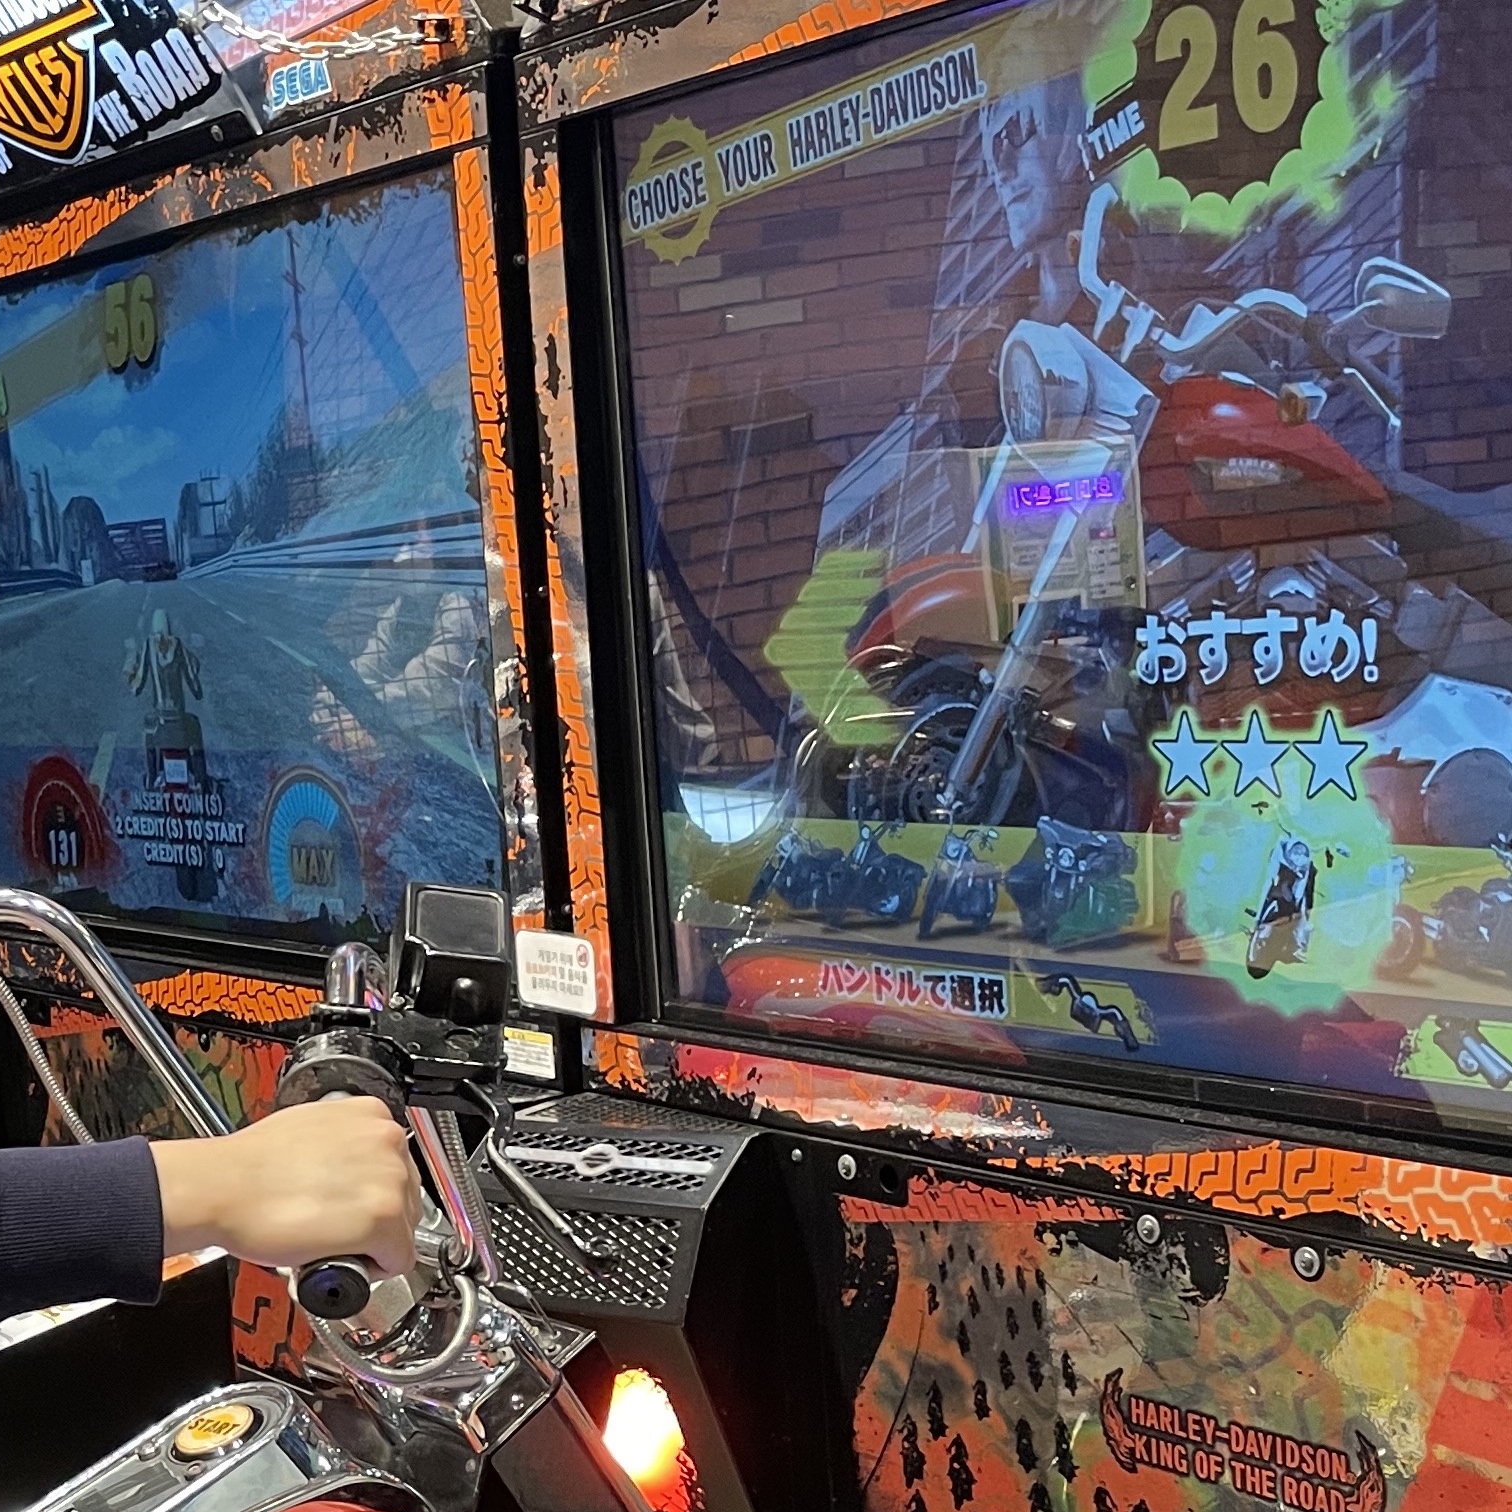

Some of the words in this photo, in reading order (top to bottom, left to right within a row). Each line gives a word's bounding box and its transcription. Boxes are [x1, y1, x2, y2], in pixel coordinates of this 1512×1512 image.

[99, 28, 210, 123] ROAD
[271, 60, 330, 107] SEGA
[1155, 0, 1299, 151] 26
[93, 89, 140, 142] THE
[626, 158, 708, 233] CHOOSE
[716, 130, 778, 195] YOUR
[787, 46, 984, 170] HARLEY-DAVIDSON
[1088, 101, 1146, 160] TIME
[105, 273, 156, 368] 56
[1135, 608, 1379, 685] おすすめ!
[115, 816, 124, 834] 2
[187, 820, 203, 840] TO
[205, 820, 245, 844] START
[132, 792, 171, 813] INSERT
[49, 828, 78, 867] 131
[187, 1417, 240, 1436] START
[1130, 1396, 1350, 1484] HARLEY-DAVIDSON
[1134, 1433, 1188, 1474] KING
[1194, 1450, 1224, 1482] OF
[1230, 1459, 1277, 1499] THE
